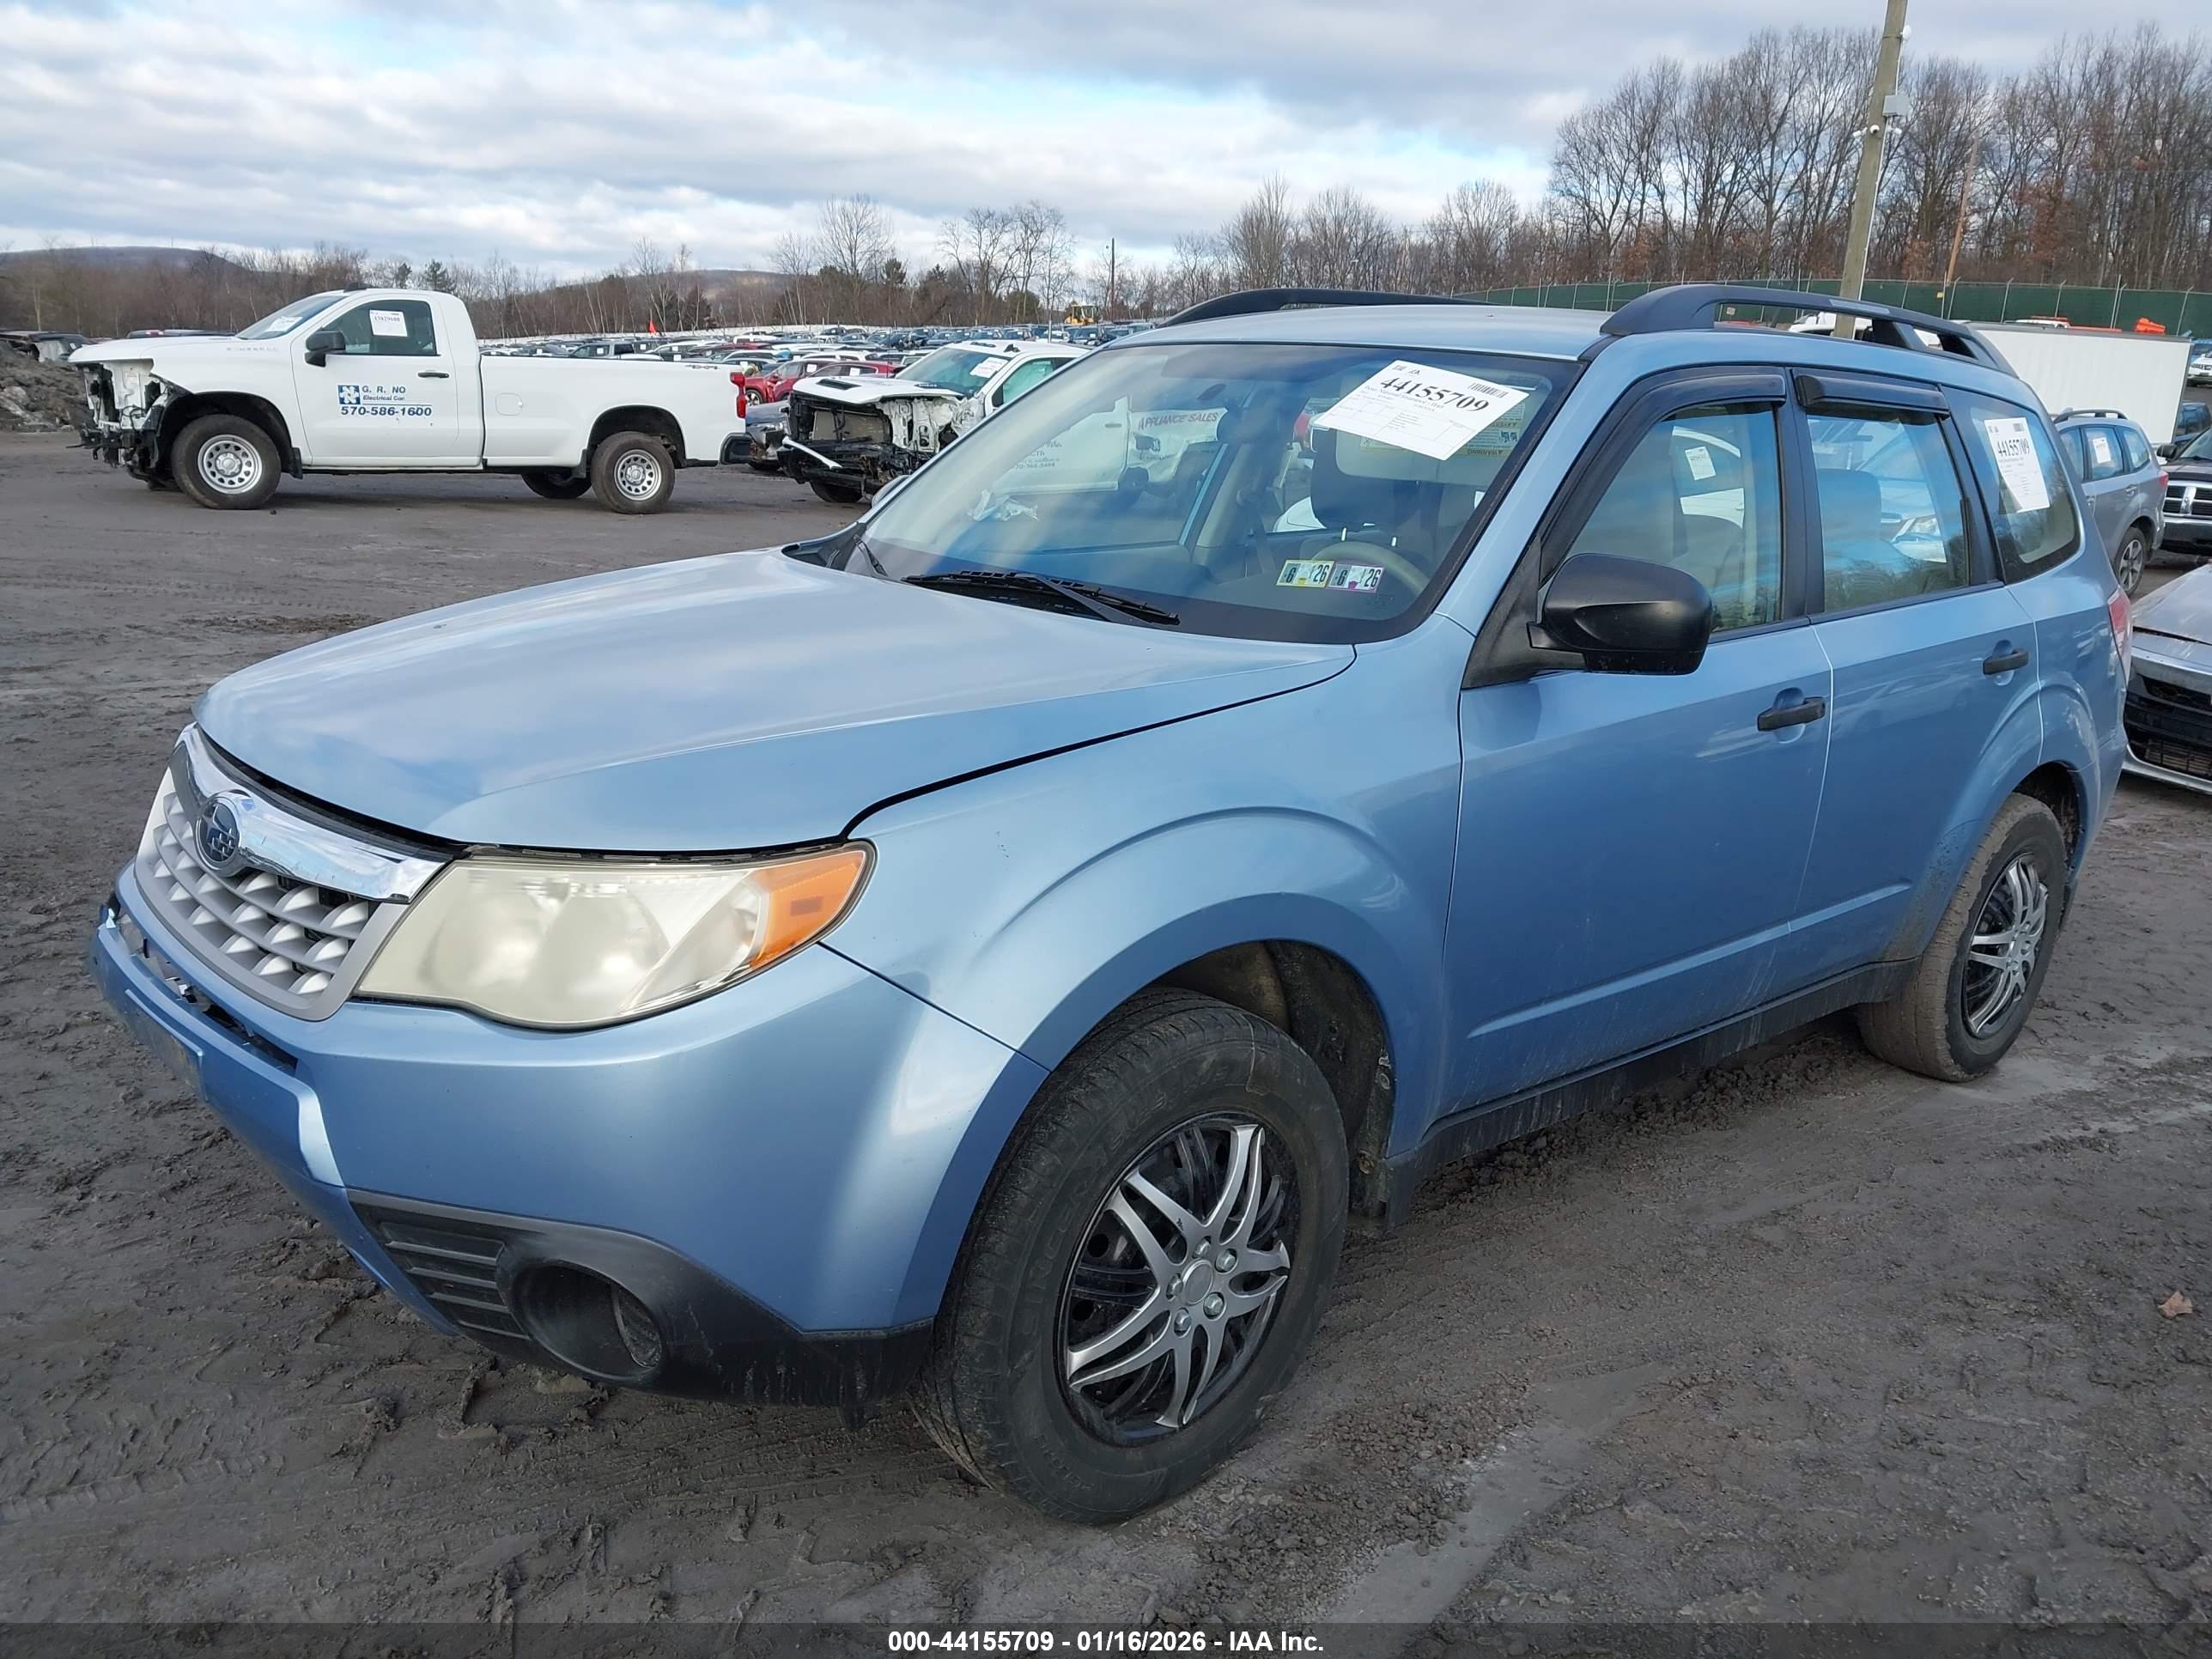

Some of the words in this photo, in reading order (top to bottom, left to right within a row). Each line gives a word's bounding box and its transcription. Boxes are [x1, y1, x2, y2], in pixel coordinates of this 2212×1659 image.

[362, 385, 372, 393] G.
[1380, 377, 1489, 412] 44155709
[341, 406, 432, 416] 570-586-1600
[1139, 415, 1188, 430] APPLIANCE
[1188, 412, 1218, 422] SALES
[1313, 564, 1330, 582] 26
[1364, 568, 1382, 587] 26
